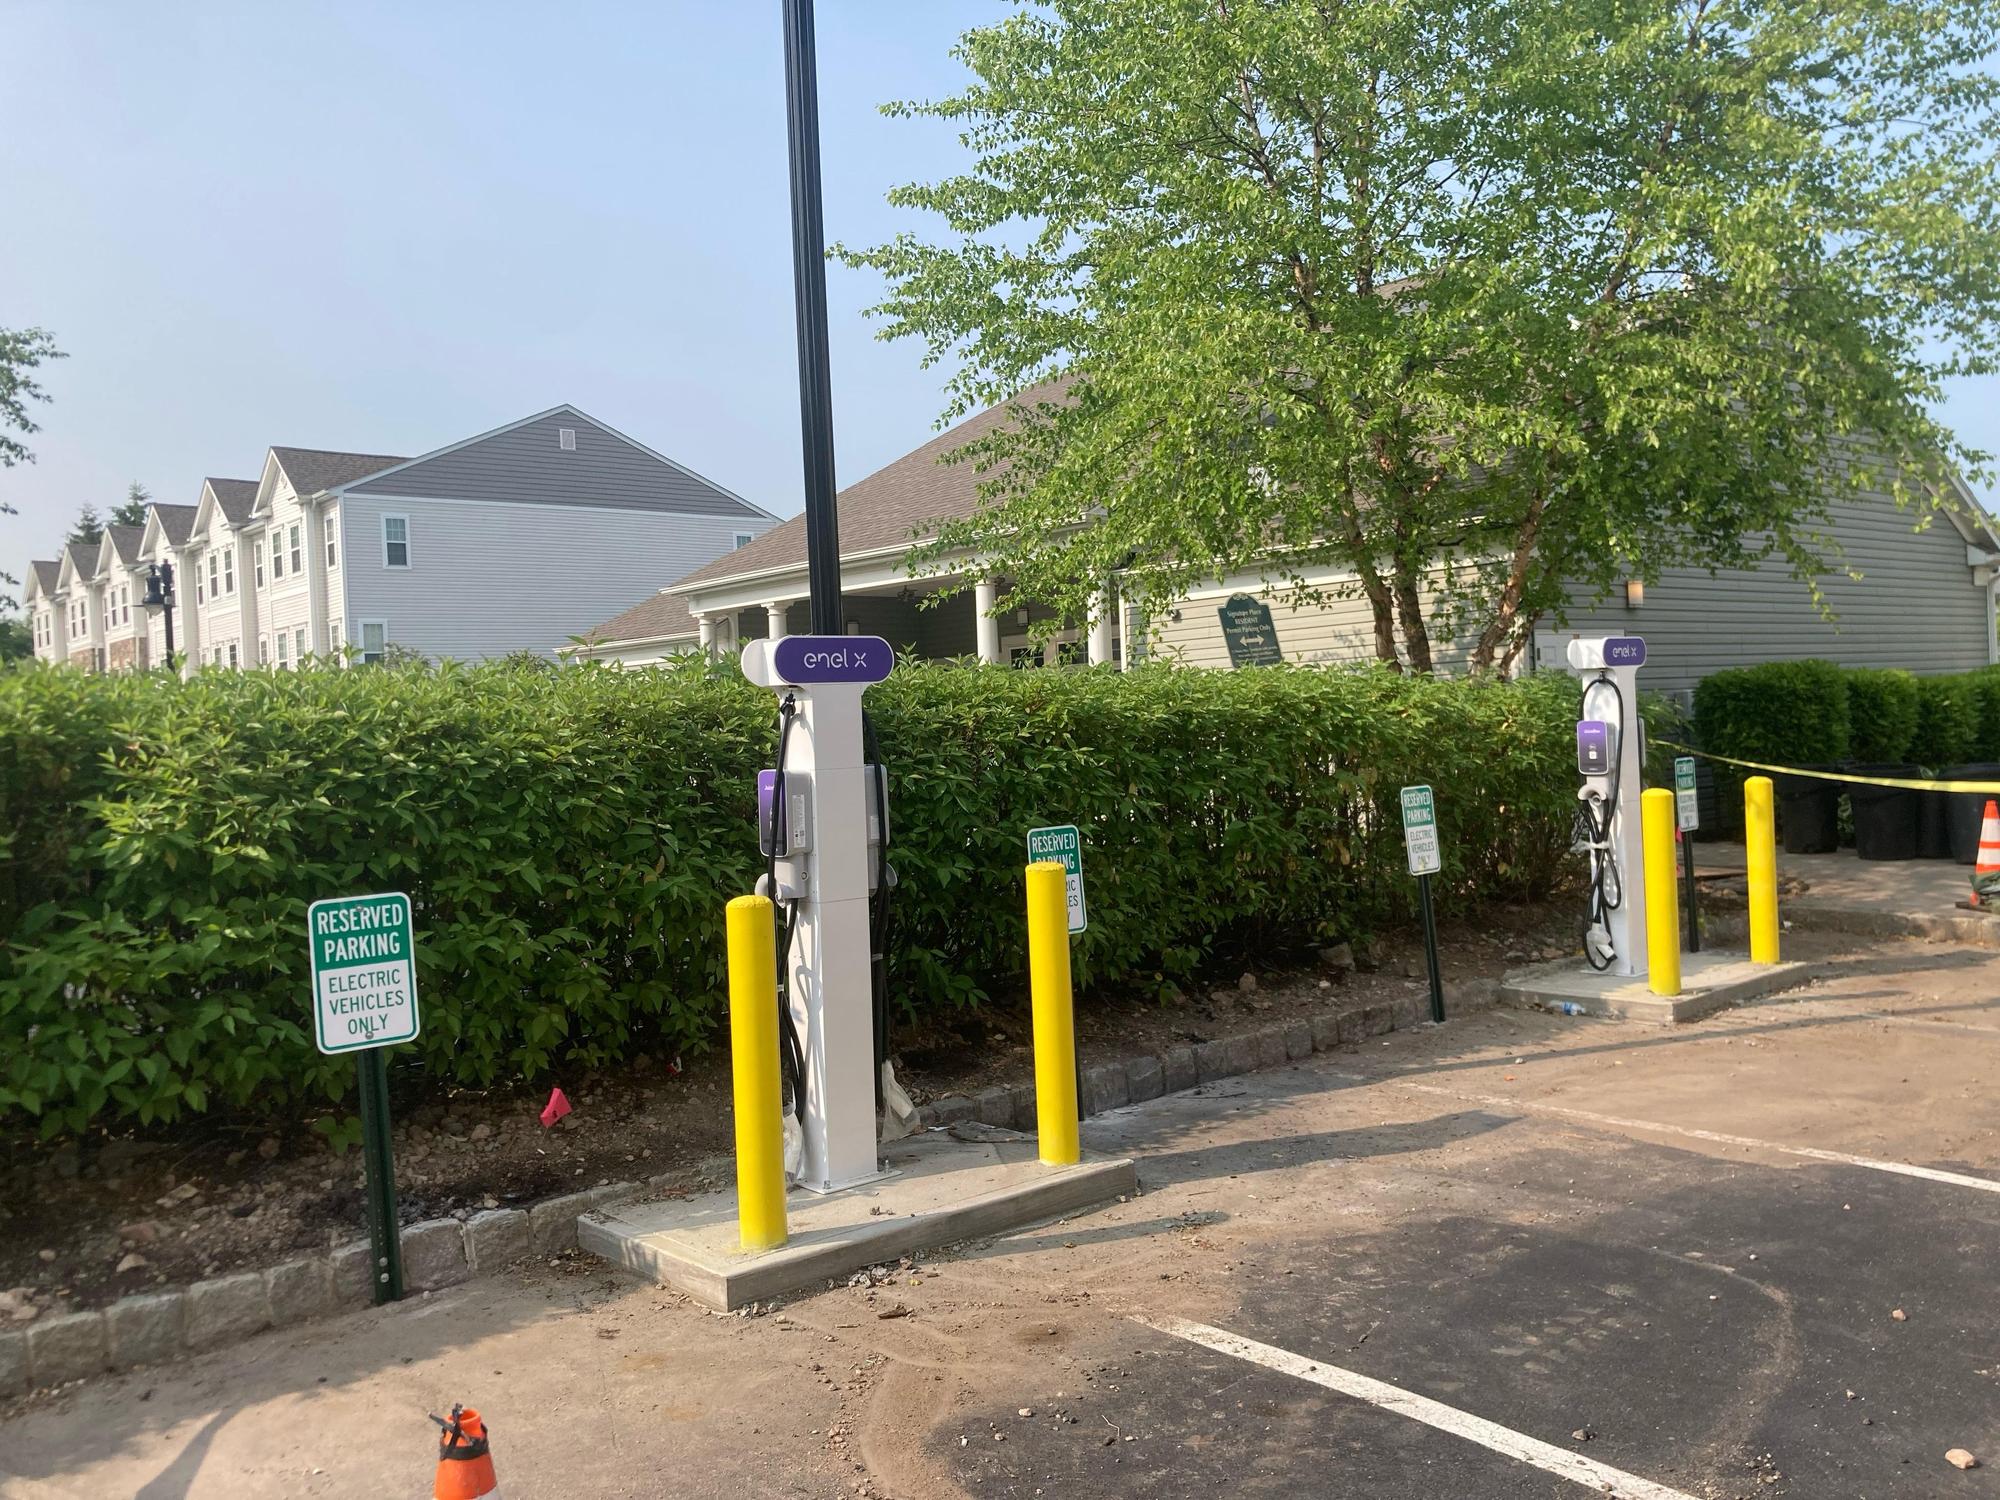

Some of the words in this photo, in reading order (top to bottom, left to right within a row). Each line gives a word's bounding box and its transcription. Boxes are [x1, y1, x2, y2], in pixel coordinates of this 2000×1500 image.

[1235, 617, 1258, 625] RESIDENT
[1241, 625, 1260, 633] Parking
[1260, 624, 1271, 632] Only
[804, 648, 848, 669] enel
[1612, 644, 1630, 658] enel
[1404, 792, 1431, 807] RESERVED
[1406, 808, 1431, 823] PARKING
[1032, 833, 1075, 853] RESERVED
[1410, 829, 1433, 841] ELECTRIC
[1411, 841, 1435, 854] VEHICLES
[317, 904, 403, 935] RESERVED
[324, 932, 400, 963] PARKING
[329, 968, 400, 994] ELECTRIC
[329, 990, 404, 1015] VEHICLES
[348, 1014, 388, 1034] ONLY
